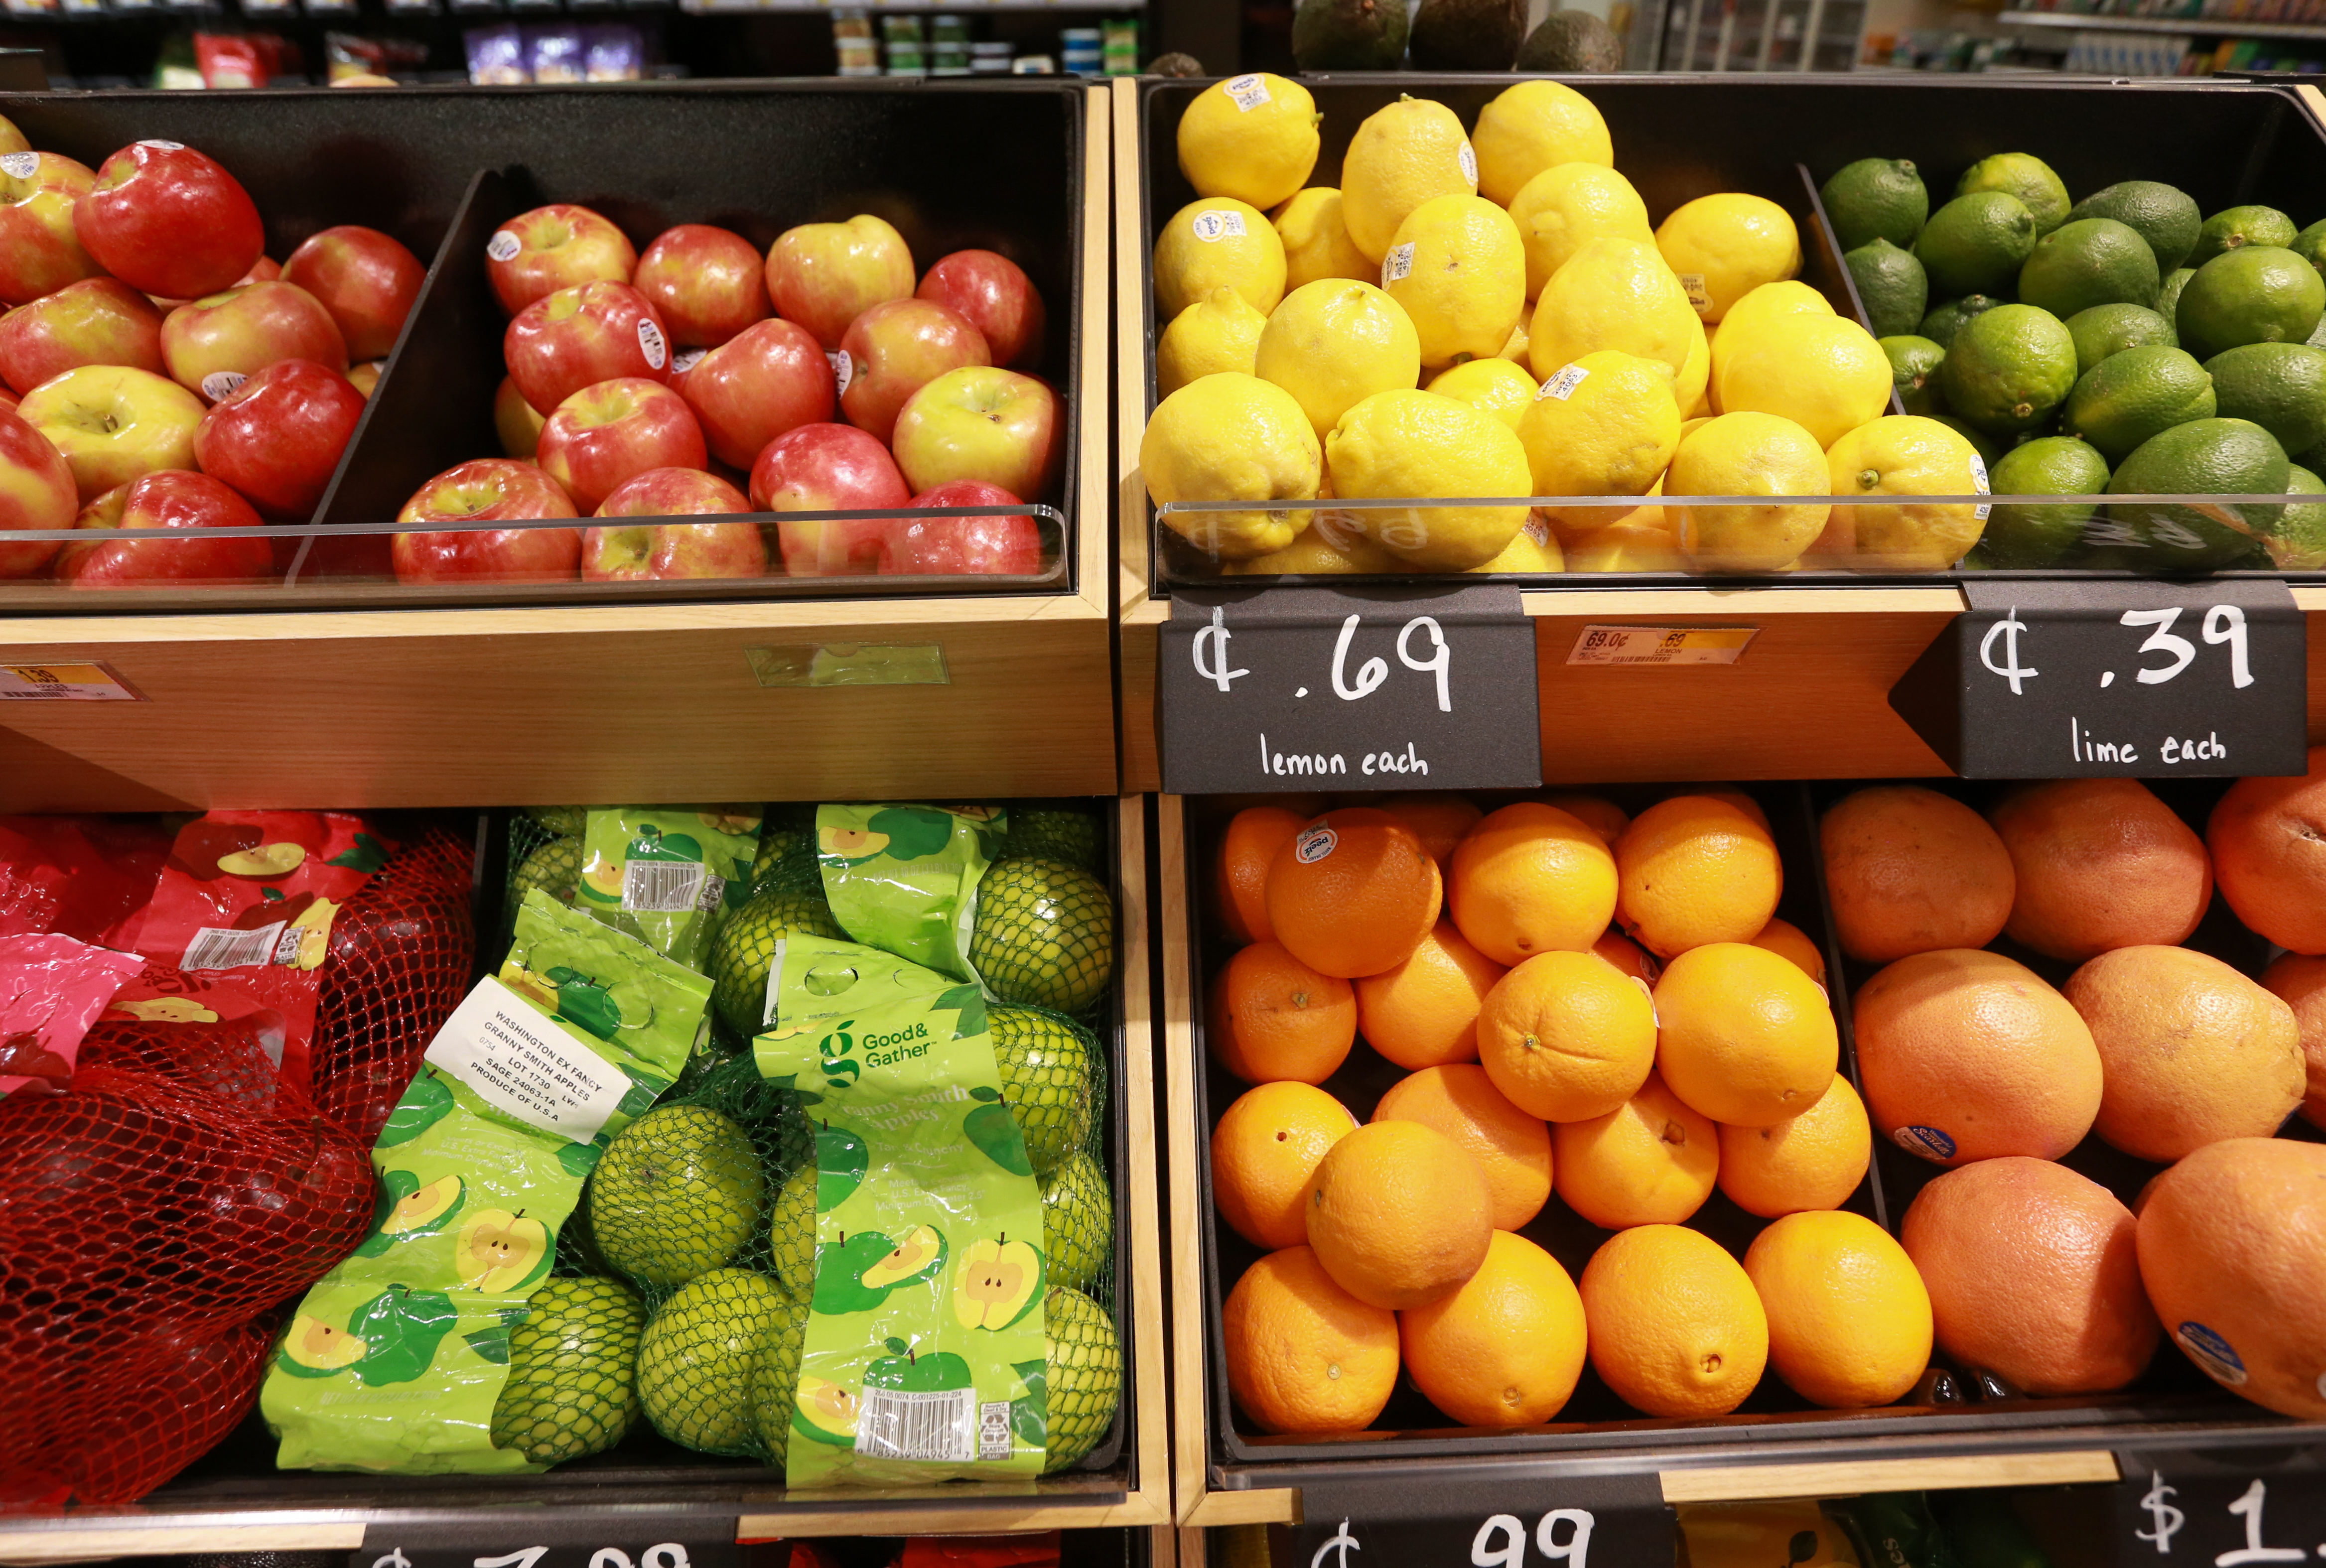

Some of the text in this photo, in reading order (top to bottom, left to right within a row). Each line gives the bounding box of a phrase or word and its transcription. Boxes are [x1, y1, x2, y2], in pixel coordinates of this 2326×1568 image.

[1562, 374, 1578, 392] 4053
[1524, 523, 1540, 538] 4053
[1586, 632, 1686, 651] 69.0¢ .69
[2100, 604, 2255, 689] .39
[1295, 613, 1452, 712] .69
[18, 669, 59, 682] 1.39
[2071, 716, 2227, 764] lime each
[1260, 733, 1429, 776] lemon each
[1304, 836, 1329, 855] peelz
[1321, 846, 1332, 856] NAVEL
[479, 1037, 496, 1051] 0754
[495, 1011, 603, 1093] WASHINGTON EX FANCY
[484, 1022, 591, 1101] GRANNY SMITH APPLES
[486, 1058, 556, 1107] SAGE 24063-1A
[508, 1057, 551, 1089] LOT 1730
[470, 1061, 517, 1096] PRODUCE
[517, 1095, 532, 1105] OF
[533, 1103, 559, 1122] U.S.A
[842, 1084, 970, 1117] ranny Smith
[870, 1109, 939, 1131] Apples
[441, 1141, 458, 1150] U.S.
[462, 1145, 486, 1155] Extra
[915, 1142, 963, 1159] Crunchy
[421, 1148, 507, 1171] Minimum Diameter
[891, 1188, 911, 1199] U.S.
[914, 1187, 939, 1196] Exa
[876, 1200, 921, 1211] Minimum
[916, 1448, 950, 1460] 04945
[2135, 1468, 2186, 1554] $
